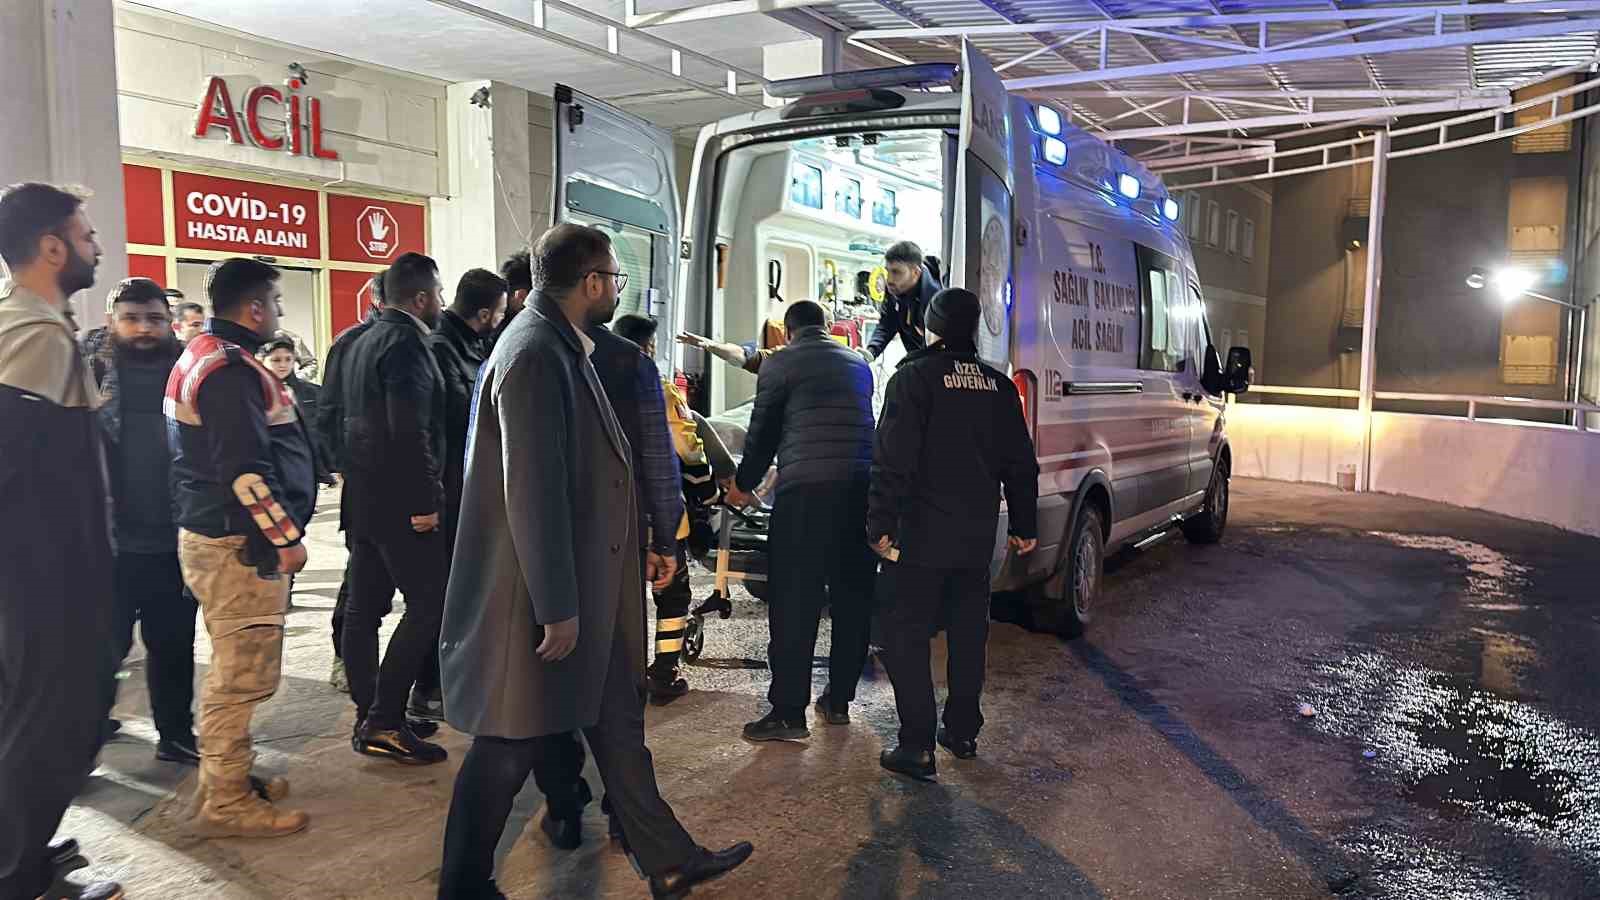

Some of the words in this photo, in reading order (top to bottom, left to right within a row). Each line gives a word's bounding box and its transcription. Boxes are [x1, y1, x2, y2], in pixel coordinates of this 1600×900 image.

[193, 75, 338, 159] ACİL
[186, 191, 307, 226] COVİD-19
[187, 220, 250, 243] HASTA
[253, 228, 308, 249] ALANI
[954, 359, 984, 377] ÖZEL
